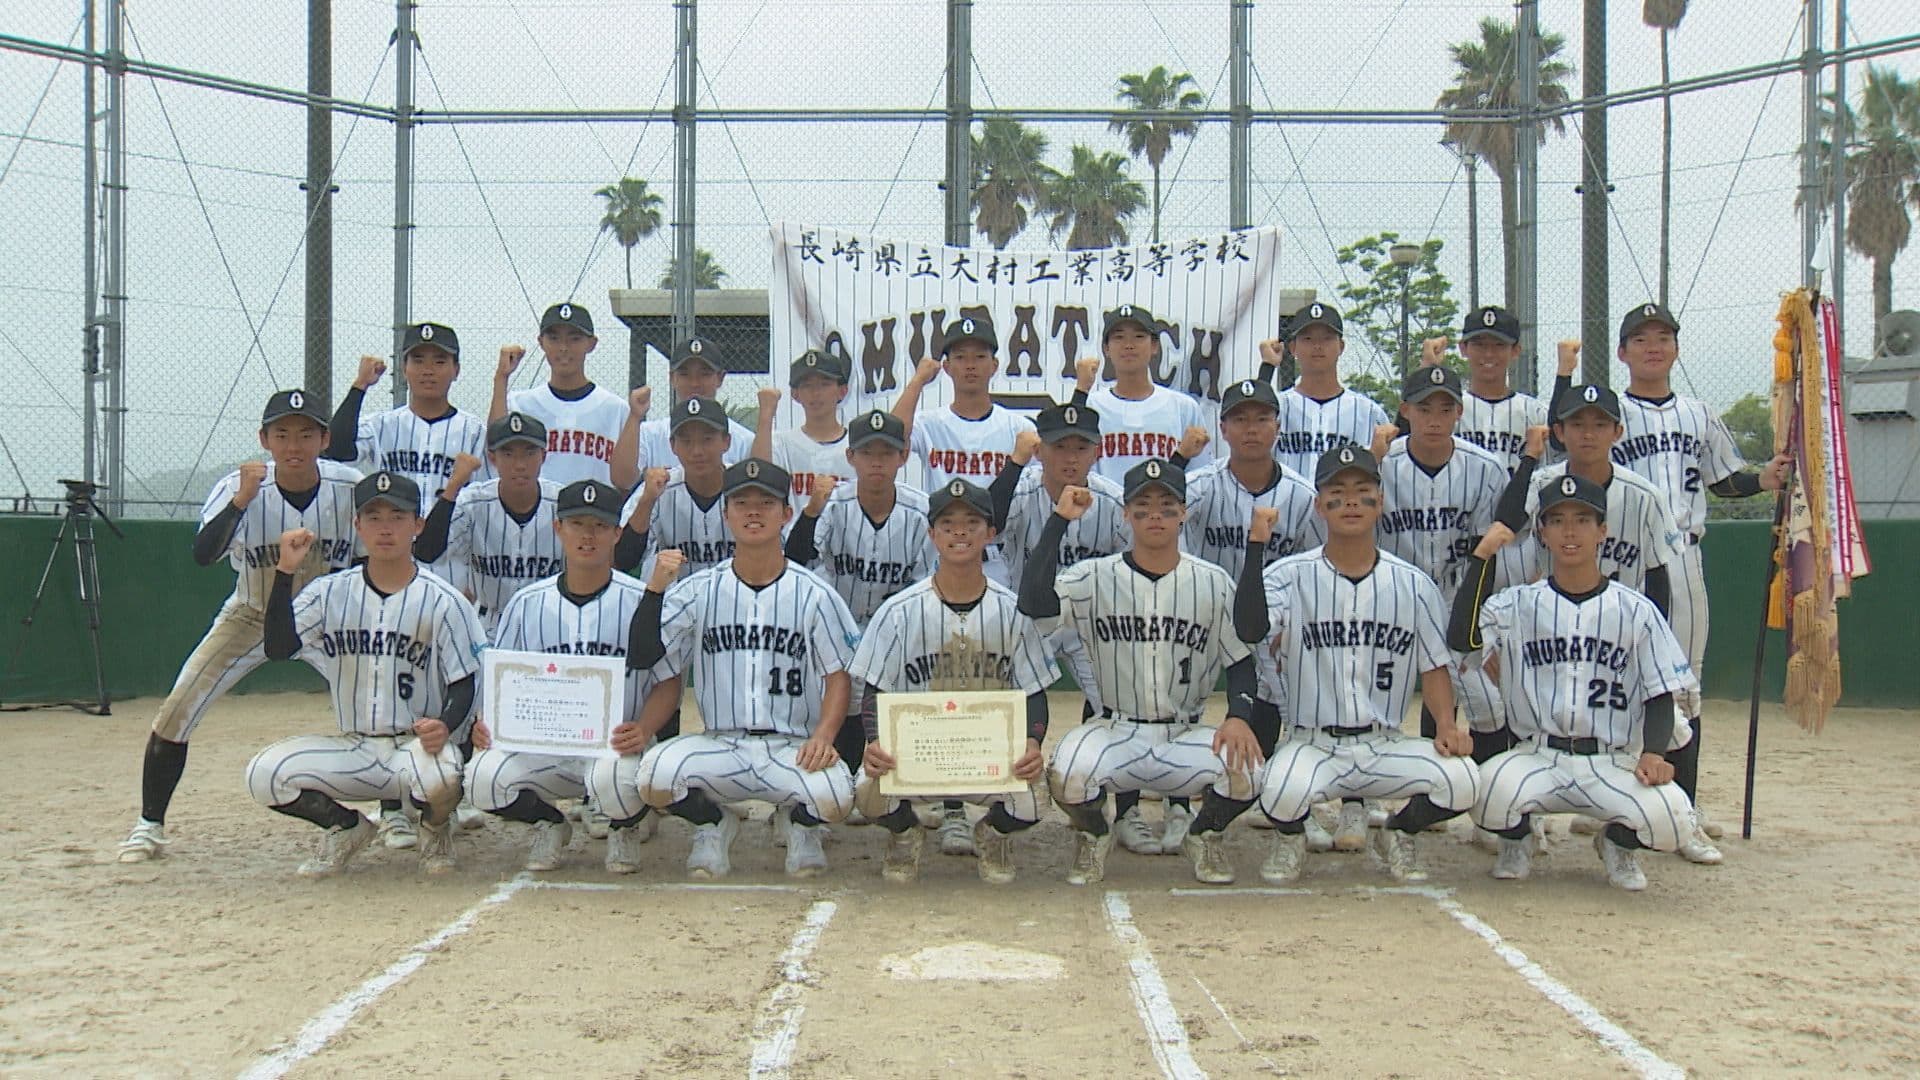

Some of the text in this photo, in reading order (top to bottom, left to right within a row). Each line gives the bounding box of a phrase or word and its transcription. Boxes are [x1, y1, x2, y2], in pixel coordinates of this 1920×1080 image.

[793, 231, 1250, 286] 長崎県立大村工業高等学校
[323, 627, 432, 670] OMURATECH
[1096, 615, 1210, 653] OMURATECH
[1302, 619, 1415, 656] OMURATECH
[398, 672, 416, 700] 6
[768, 667, 804, 696] 18
[1178, 657, 1191, 684] 1
[1376, 661, 1394, 691] 5
[1588, 679, 1628, 711] 25
